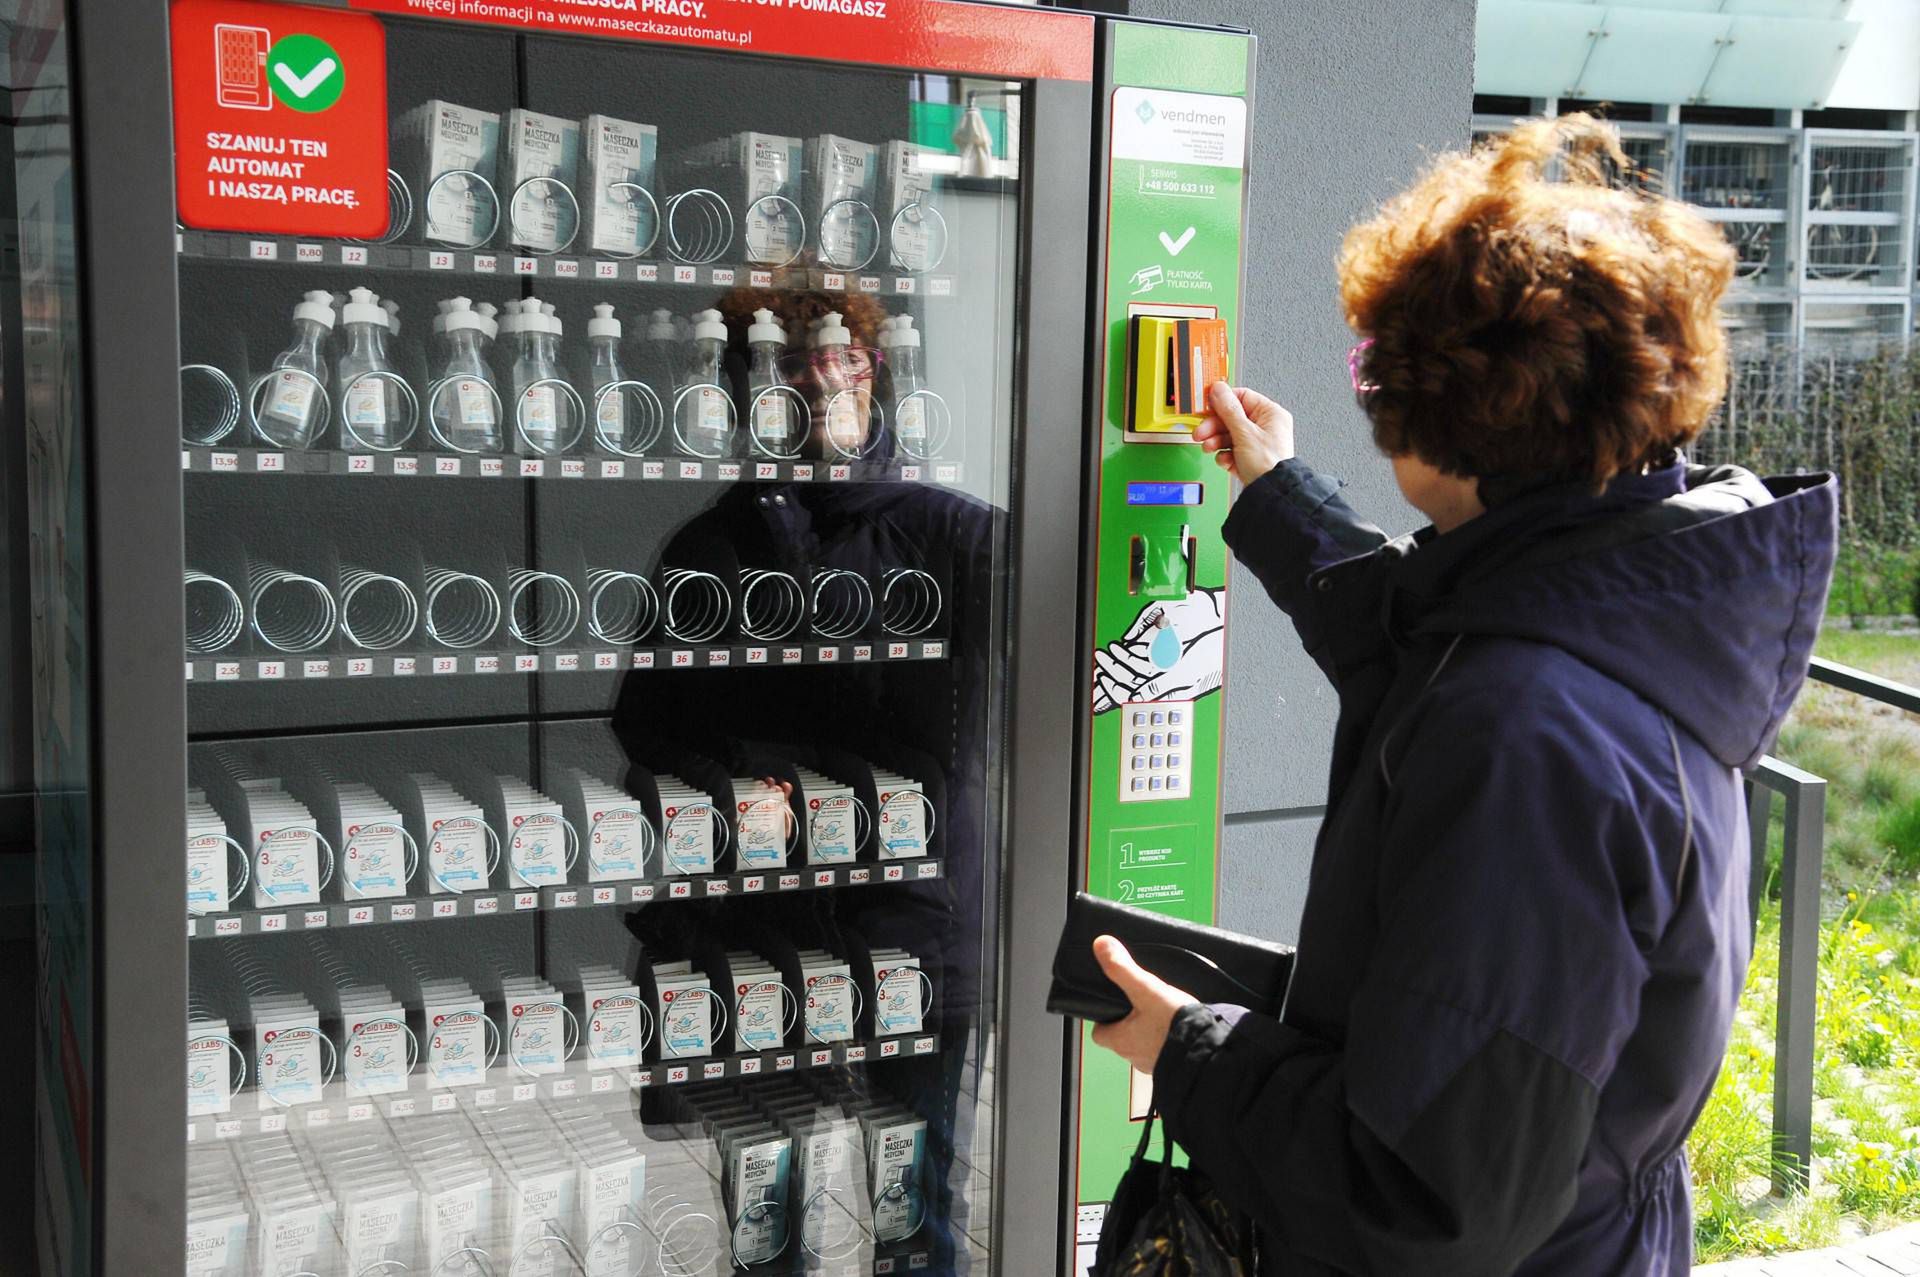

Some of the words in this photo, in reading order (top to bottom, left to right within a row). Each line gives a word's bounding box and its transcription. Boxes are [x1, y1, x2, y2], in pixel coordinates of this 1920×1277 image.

[641, 0, 707, 18] PRACY.
[407, 0, 455, 14] Więcej
[460, 0, 533, 23] informacji
[537, 11, 554, 22] na
[558, 13, 753, 44] www.maseczkazautomatu.pl
[1161, 109, 1226, 125] vendmen
[441, 118, 480, 137] MASECZKA
[524, 127, 561, 145] MASECZKA
[206, 132, 285, 155] SZANUJ
[288, 138, 328, 158] TEN
[603, 133, 639, 149] MASECZKA
[207, 157, 305, 179] AUTOMAT
[1146, 181, 1161, 191] +48
[1163, 182, 1179, 191] 500
[1181, 183, 1197, 193] 633
[1199, 185, 1215, 194] 112
[208, 181, 215, 197] I
[219, 182, 287, 205] NASZĄ
[291, 186, 360, 209] PRACĘ.
[257, 246, 270, 256] 11
[348, 252, 361, 261] 12
[435, 256, 448, 265] 13
[520, 262, 532, 271] 14
[600, 266, 612, 275] 15
[679, 271, 691, 280] 16
[713, 272, 732, 281] 8,80
[828, 277, 839, 287] 18
[861, 279, 879, 288] 8,80
[898, 281, 910, 290] 19
[263, 458, 276, 466] 21
[354, 460, 367, 468] 22
[440, 462, 454, 471] 23
[525, 463, 537, 473] 24
[607, 465, 619, 474] 25
[685, 467, 696, 475] 26
[760, 467, 772, 475] 27
[833, 469, 845, 478] 28
[905, 469, 916, 478] 29
[822, 650, 833, 659] 38
[892, 646, 903, 655] 39
[676, 655, 687, 663] 36
[750, 651, 761, 660] 37
[439, 661, 451, 669] 33
[520, 659, 532, 668] 34
[600, 657, 611, 666] 35
[264, 666, 276, 674] 31
[354, 663, 366, 671] 32
[888, 869, 900, 878] 49
[818, 874, 829, 883] 48
[748, 879, 759, 888] 47
[674, 886, 686, 894] 46
[598, 891, 610, 900] 45
[520, 896, 532, 905] 44
[440, 904, 452, 913] 43
[355, 911, 367, 920] 42
[266, 919, 279, 928] 41
[883, 1044, 894, 1053] 59
[815, 1054, 826, 1063] 58
[745, 1062, 755, 1070] 57
[672, 1071, 683, 1080] 56
[885, 1138, 913, 1152] MASECZKA
[879, 1262, 890, 1271] 69
